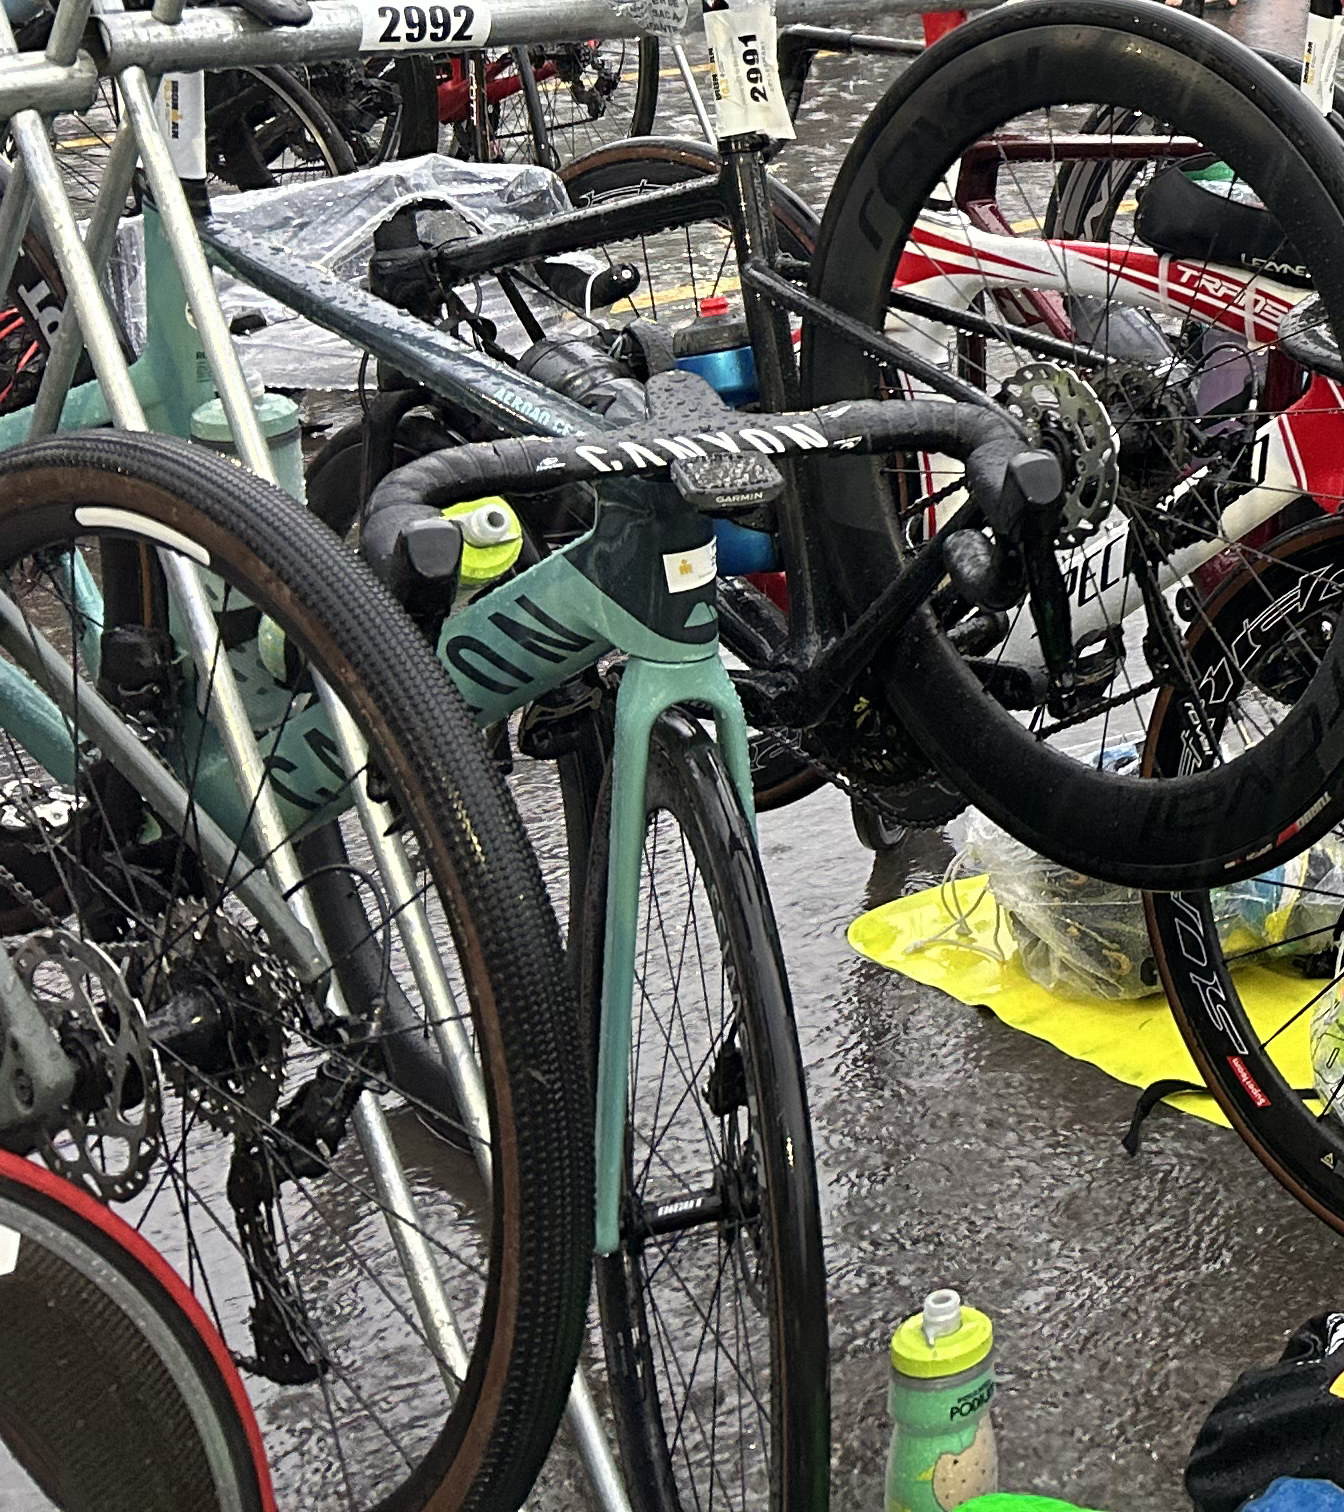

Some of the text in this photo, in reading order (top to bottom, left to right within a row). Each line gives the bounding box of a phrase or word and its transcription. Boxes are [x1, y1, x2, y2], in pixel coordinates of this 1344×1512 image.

[377, 4, 475, 44] 2992
[737, 34, 769, 104] 2991
[575, 422, 829, 473] CANYON
[714, 490, 764, 504] GARMIN
